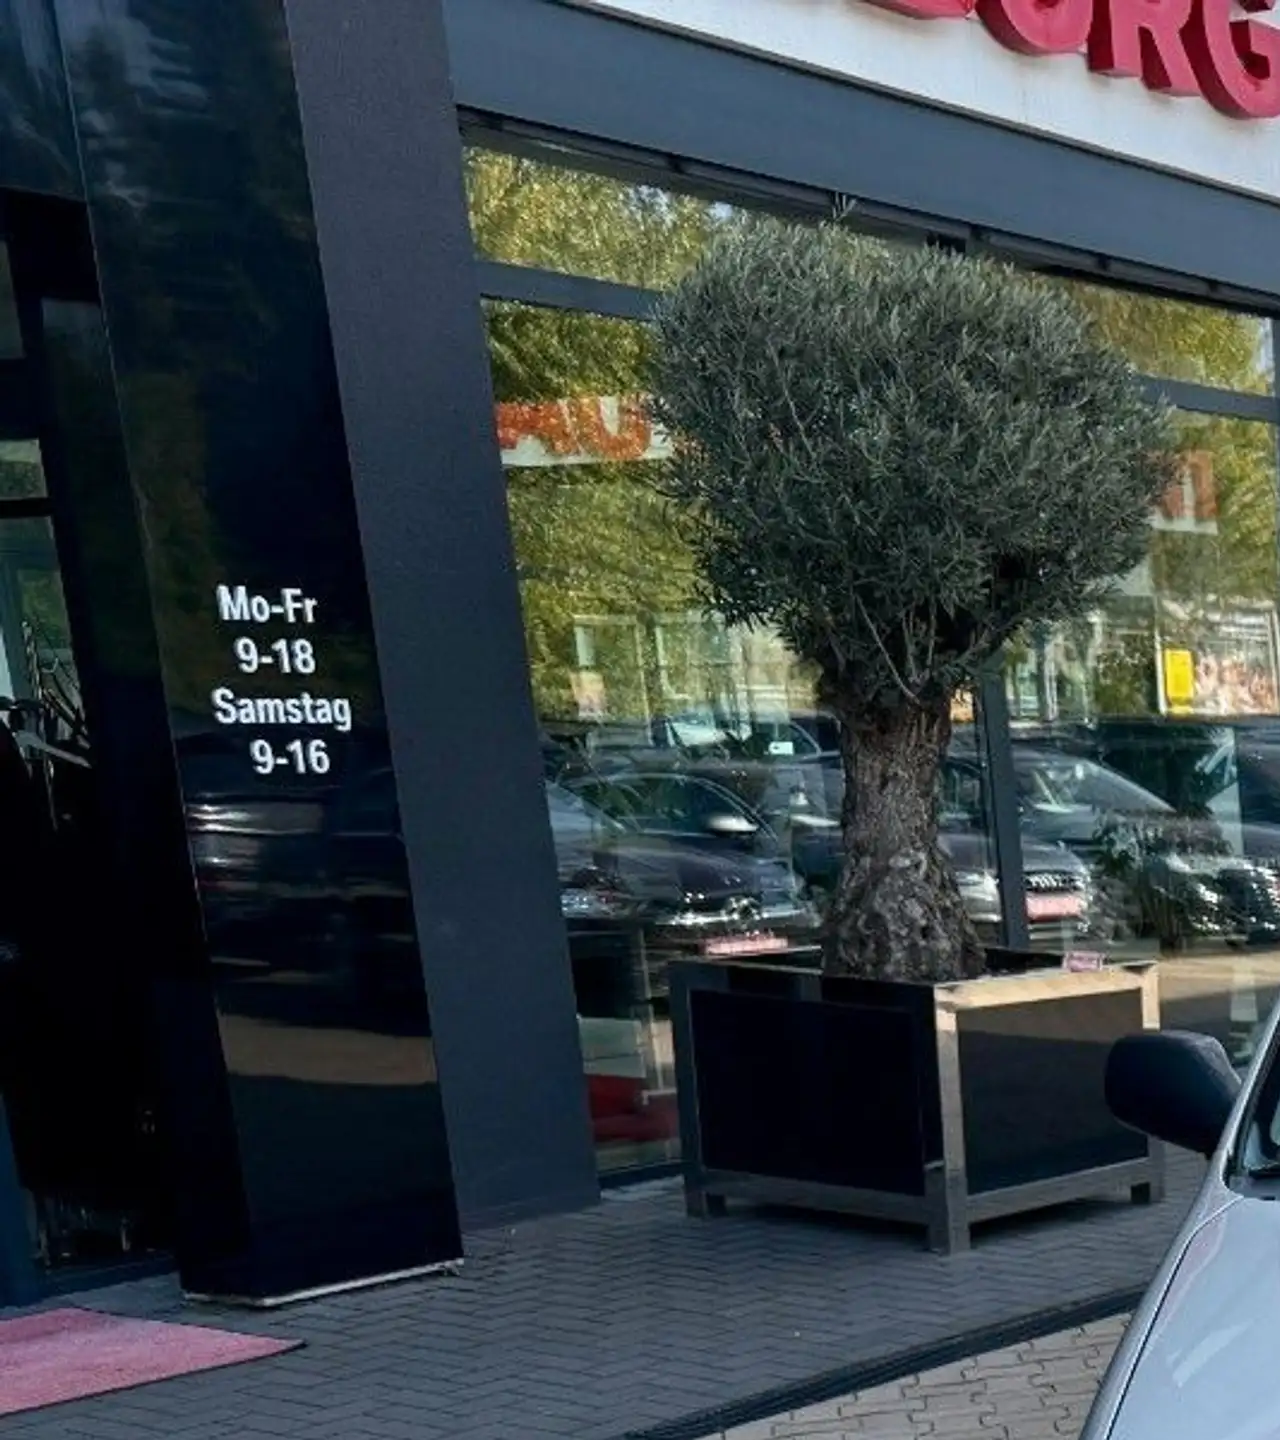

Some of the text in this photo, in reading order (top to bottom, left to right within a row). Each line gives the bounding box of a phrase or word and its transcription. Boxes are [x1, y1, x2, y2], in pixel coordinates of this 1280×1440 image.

[215, 584, 319, 625] Mo-Fr
[234, 636, 316, 675] 9-18
[211, 687, 352, 732] Samstag
[249, 738, 331, 775] 9-16
